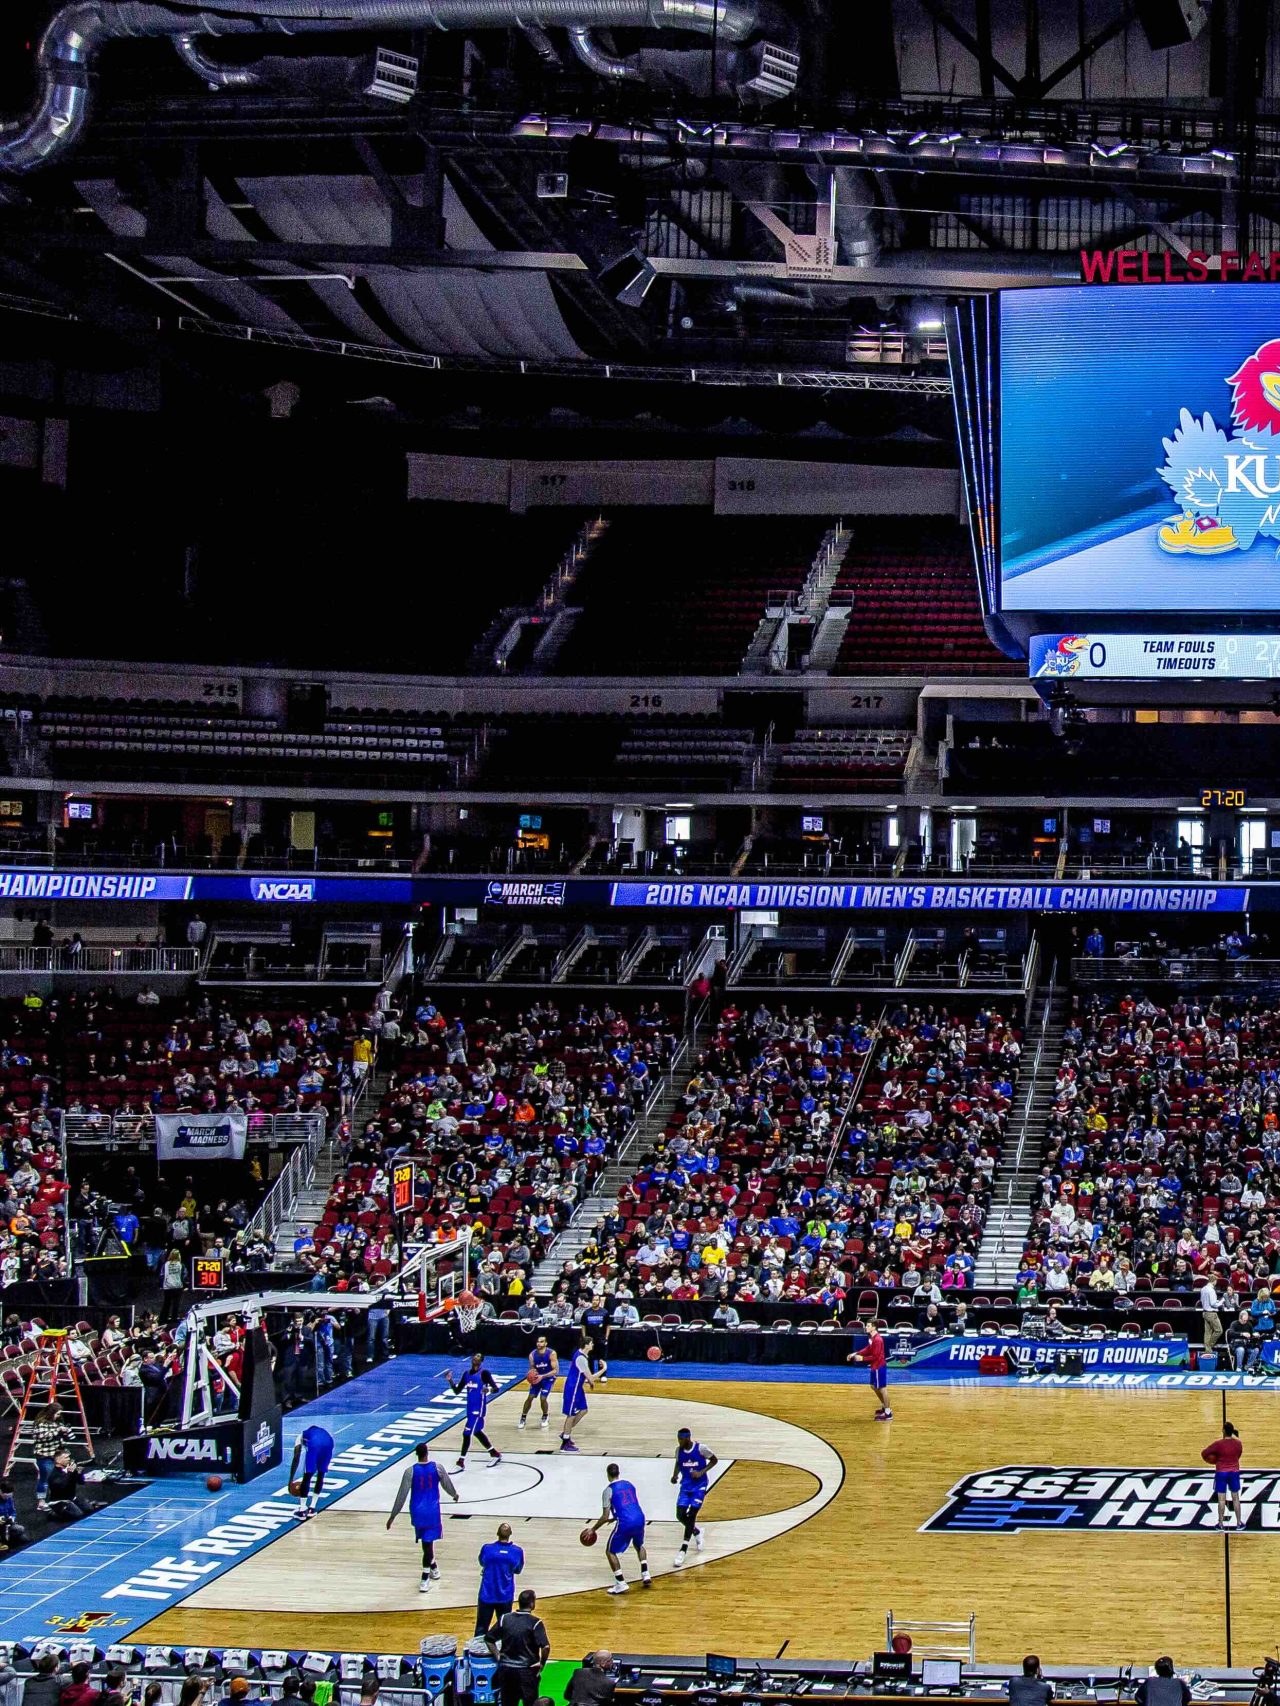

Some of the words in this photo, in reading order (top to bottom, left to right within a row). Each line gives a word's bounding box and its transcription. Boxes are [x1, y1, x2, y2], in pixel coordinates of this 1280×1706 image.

[1080, 250, 1208, 283] WELLS
[1143, 640, 1174, 653] TEAM
[1178, 640, 1215, 653] FOULS
[1089, 642, 1107, 668] 0
[1156, 657, 1216, 670] TIMEOUTS
[203, 684, 239, 698] 215
[629, 695, 662, 708] 216
[851, 696, 884, 709] 217
[1202, 789, 1245, 807] 27:20
[257, 883, 314, 900] NCAA
[502, 883, 544, 896] MARCH
[645, 884, 692, 907] 2016
[700, 884, 752, 908] NCAA
[757, 885, 845, 908] DIVISION
[848, 886, 858, 909] I
[863, 885, 926, 909] MEN'S
[932, 886, 1053, 910] BASKETBALL
[1058, 888, 1217, 912] CHAMPIONSHIP
[186, 1127, 217, 1136] MARCH
[189, 1135, 229, 1144] MADNESS
[395, 1181, 409, 1207] 30
[197, 1261, 221, 1271] 27:20
[201, 1272, 217, 1285] 30
[949, 1344, 996, 1361] FIRST
[999, 1345, 1031, 1361] ND
[1035, 1347, 1099, 1364] SEND
[1102, 1347, 1169, 1364] ROUNDS
[147, 1437, 218, 1461] NCAA
[616, 1487, 637, 1505] 21
[101, 1556, 222, 1601] THE
[183, 1500, 303, 1556] ROAD
[326, 1443, 403, 1474] THE
[368, 1407, 467, 1444] FINAL
[45, 1615, 134, 1629] STATE
